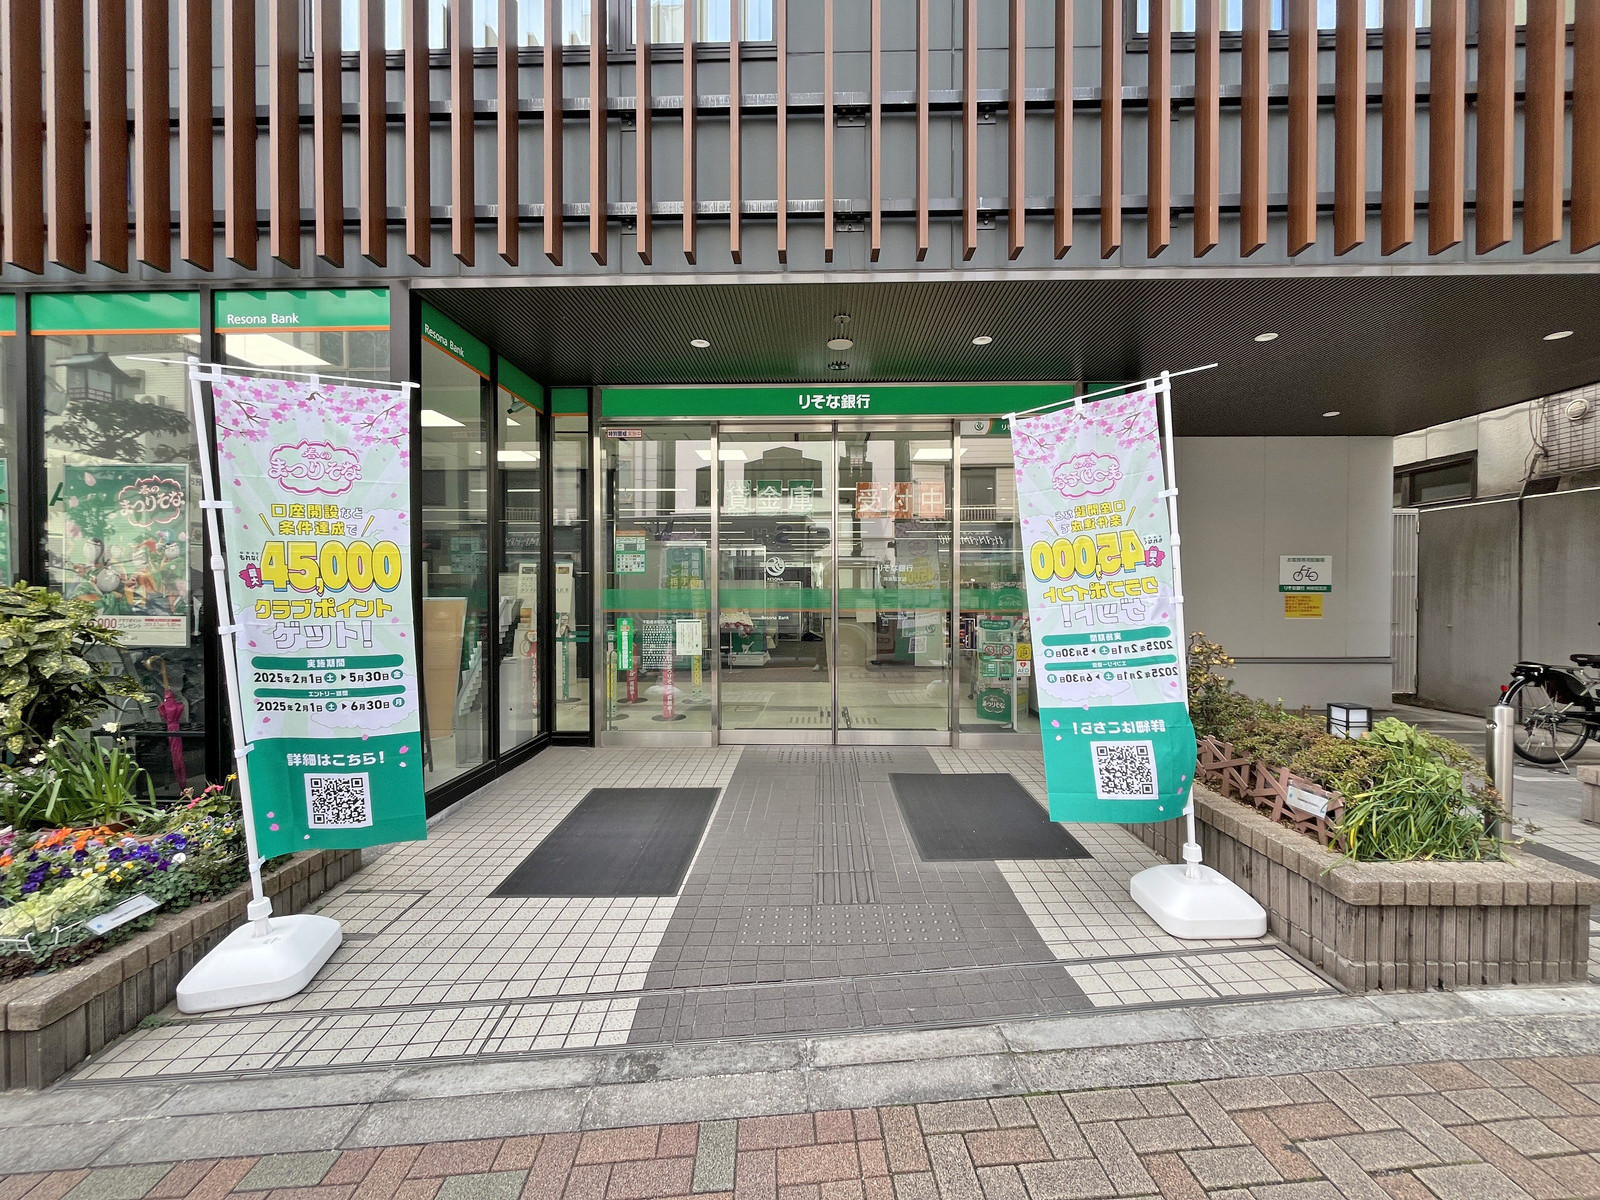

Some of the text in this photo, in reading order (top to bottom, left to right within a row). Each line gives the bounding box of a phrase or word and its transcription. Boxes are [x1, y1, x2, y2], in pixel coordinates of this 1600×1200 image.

[227, 312, 299, 325] Resona Bank
[425, 323, 465, 358] Resona Bank
[799, 394, 870, 409] りそな銀行
[302, 447, 332, 460] 春の
[268, 458, 362, 482] まつりそな
[119, 490, 185, 517] まつりそな
[726, 486, 813, 512] 貸金庫
[857, 488, 943, 513] 受付中
[271, 504, 363, 520] 口座開設など
[279, 520, 357, 536] 条件達成で
[239, 551, 259, 561] もれなく
[260, 540, 402, 597] 45,000
[877, 564, 913, 573] りそな銀行
[255, 597, 392, 619] クラブポイント
[273, 620, 373, 649] ゲット!
[306, 658, 346, 669] 実施期間
[286, 751, 385, 767] 詳細はこちら!
